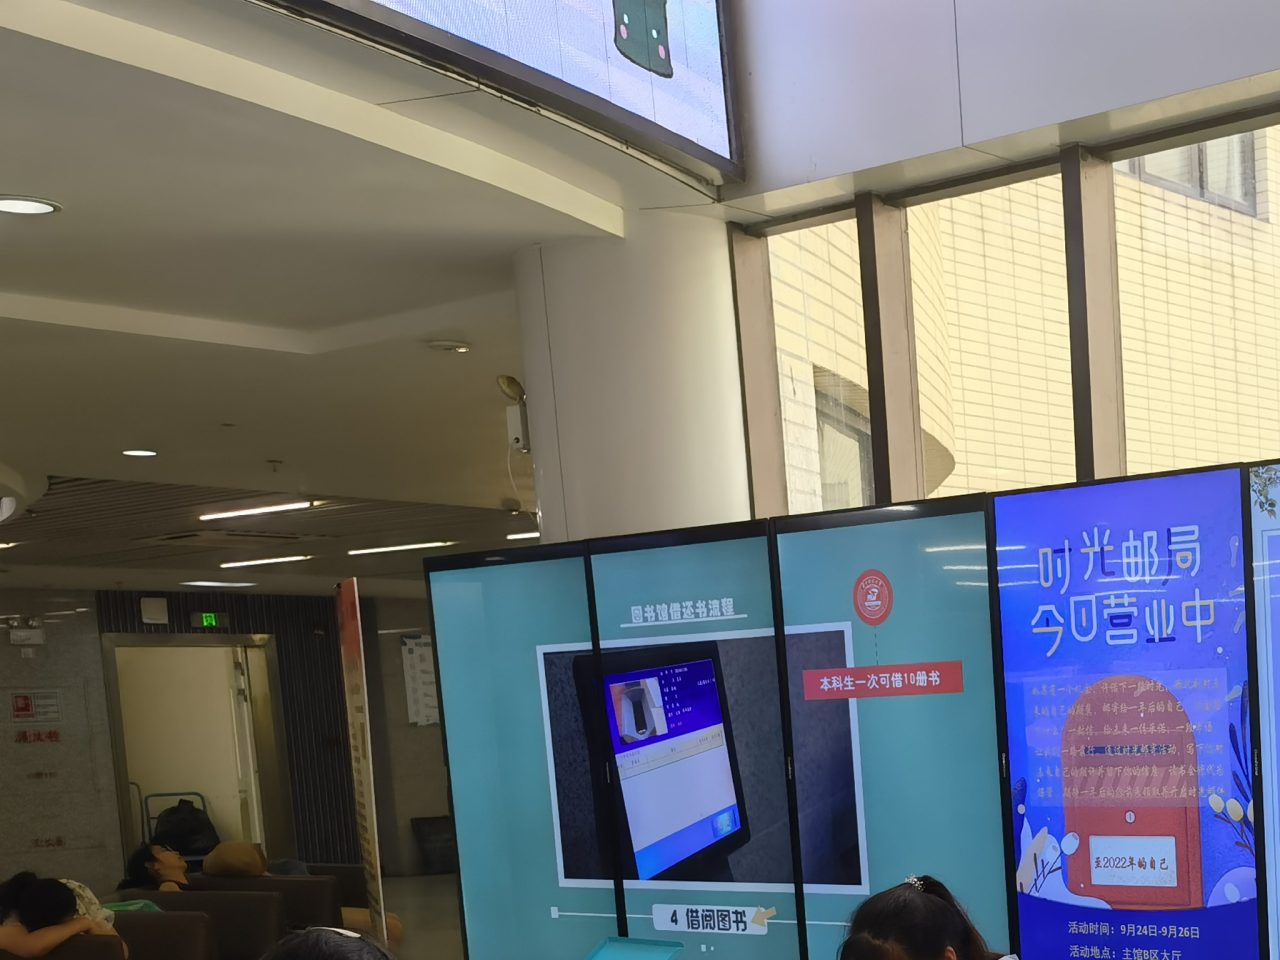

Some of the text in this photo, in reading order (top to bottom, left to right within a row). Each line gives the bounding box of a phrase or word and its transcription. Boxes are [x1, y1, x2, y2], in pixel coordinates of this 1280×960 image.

[1038, 524, 1201, 595] 时光邮局
[631, 597, 735, 624] 图书馆借还书流程
[1031, 588, 1215, 657] 今日营业中
[819, 670, 941, 692] 本科生一次可借10册书
[1094, 855, 1169, 871] 至2022年的自己
[670, 908, 748, 932] 4 借阅图书
